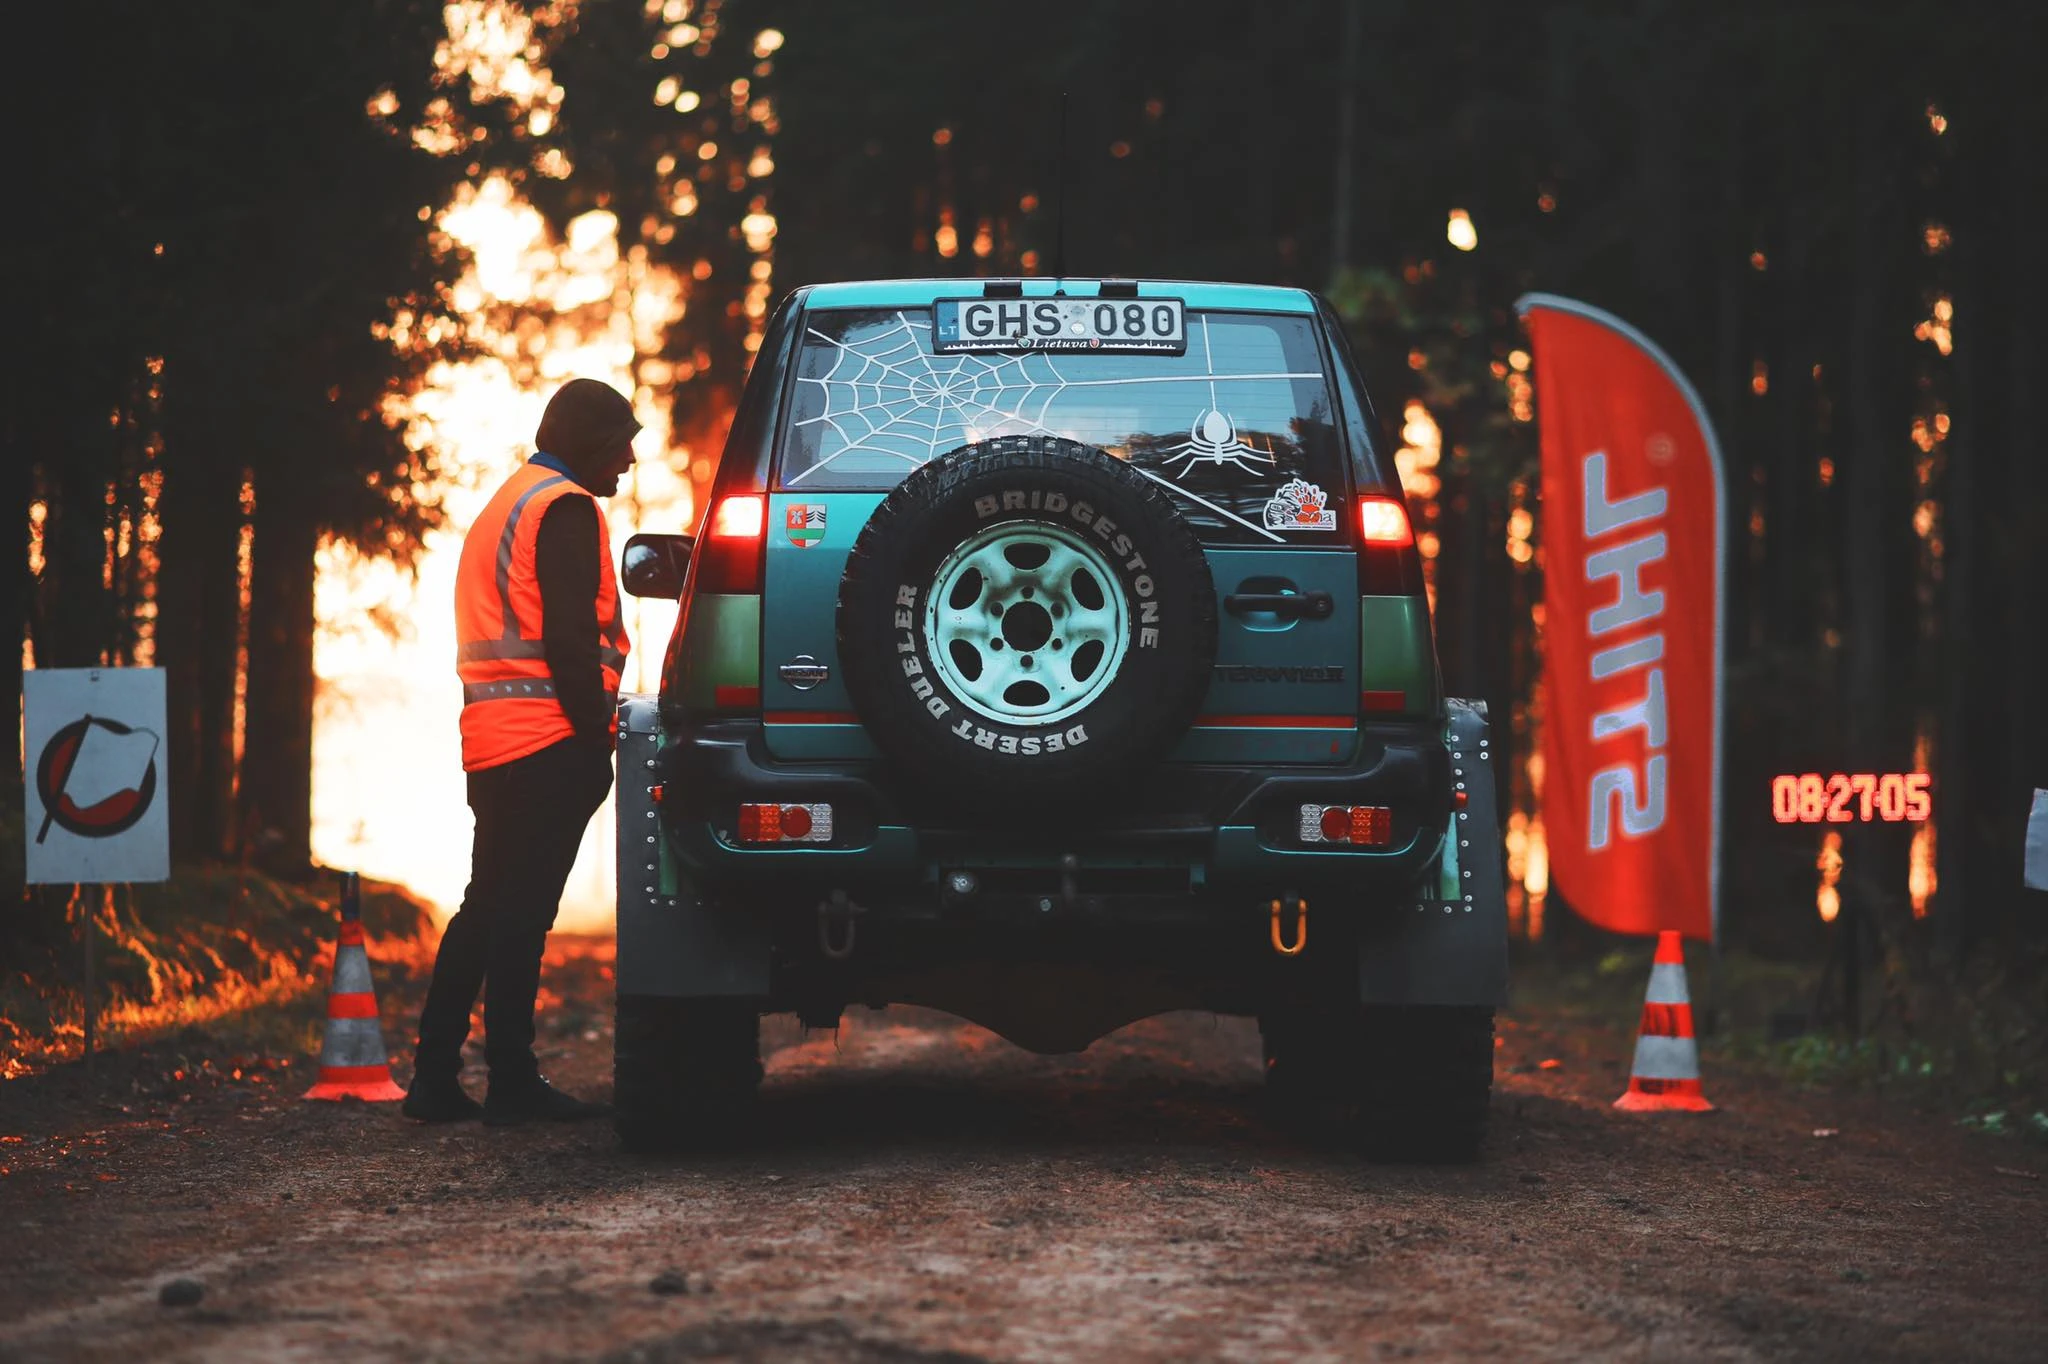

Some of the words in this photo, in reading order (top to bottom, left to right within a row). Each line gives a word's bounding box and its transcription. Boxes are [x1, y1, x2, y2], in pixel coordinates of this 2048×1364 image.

[939, 325, 956, 336] LT
[965, 303, 1061, 337] GHS
[1094, 304, 1175, 337] 080
[1032, 340, 1088, 350] Lietuva
[974, 490, 1159, 649] BRIDGESTONE
[894, 584, 951, 720] DUELER
[951, 719, 1089, 756] DESERT
